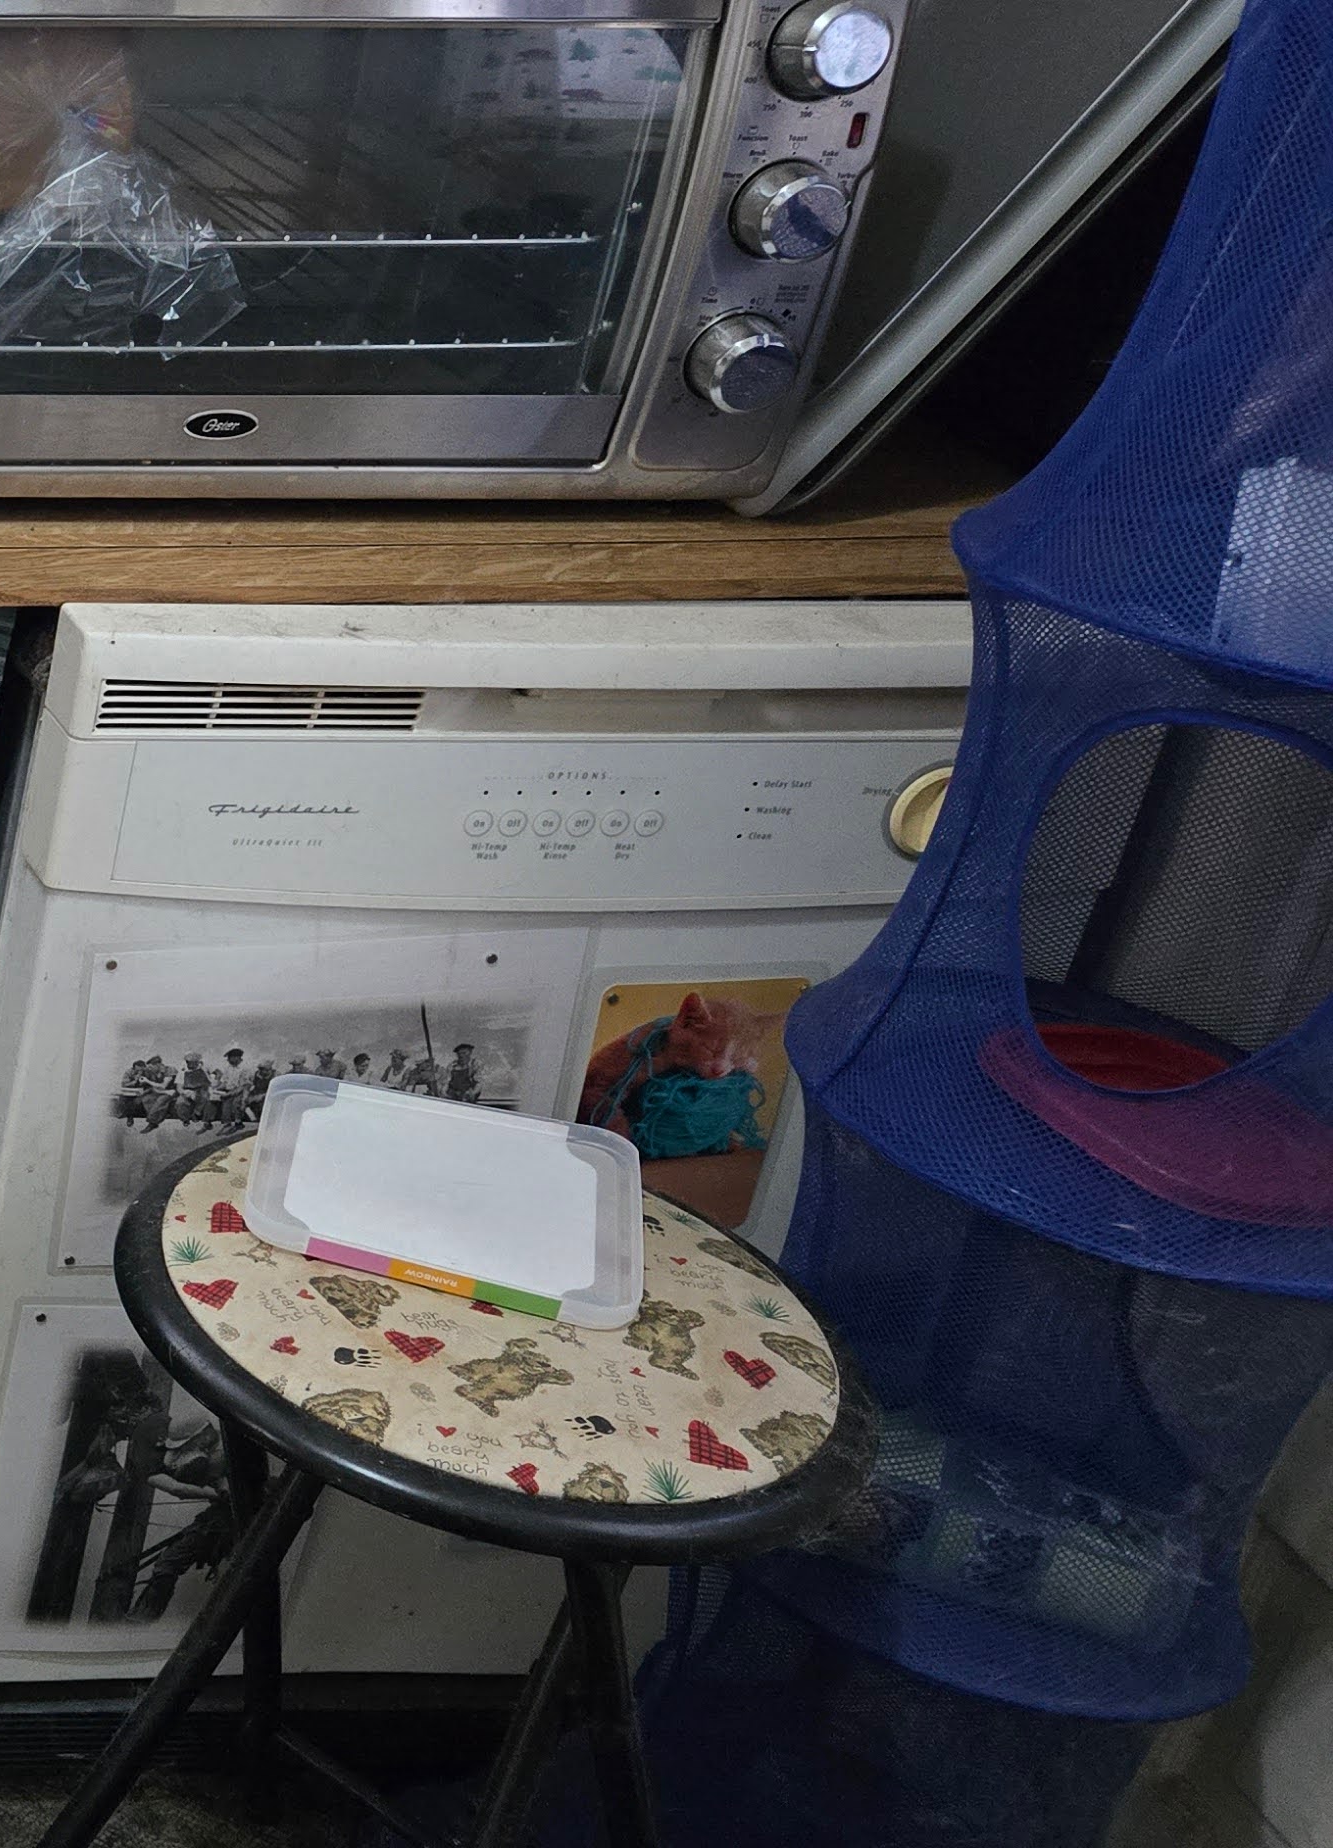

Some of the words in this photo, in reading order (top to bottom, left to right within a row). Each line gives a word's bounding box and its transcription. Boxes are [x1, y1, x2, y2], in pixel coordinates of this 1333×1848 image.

[202, 418, 241, 433] Oster
[548, 771, 608, 781] OPTIONS
[764, 780, 788, 789] Delay
[791, 780, 813, 789] Start
[862, 786, 893, 797] Drying
[208, 803, 360, 819] Frigidaire
[756, 806, 792, 816] Washing
[473, 819, 485, 828] On
[506, 819, 521, 828] Off
[542, 819, 554, 828] On
[574, 819, 589, 828] Off
[610, 819, 622, 828] On
[643, 819, 658, 828] Off
[232, 837, 300, 847] UltraQuiet
[748, 832, 772, 841] Clean
[471, 842, 508, 852] Hi-Temp
[539, 842, 576, 852] Hi-Temp
[614, 842, 635, 851] Heat
[476, 852, 499, 861] Wash
[543, 852, 568, 861] Rinse
[614, 852, 630, 861] Dry
[404, 1269, 458, 1287] RAINBOW
[256, 1289, 287, 1323] much
[271, 1287, 304, 1322] beary
[303, 1304, 331, 1326] you
[400, 1311, 439, 1323] bear
[415, 1318, 460, 1333] hugs
[633, 1383, 656, 1417] bear
[466, 1432, 503, 1449] you
[427, 1441, 490, 1465] beary
[426, 1457, 488, 1477] much
